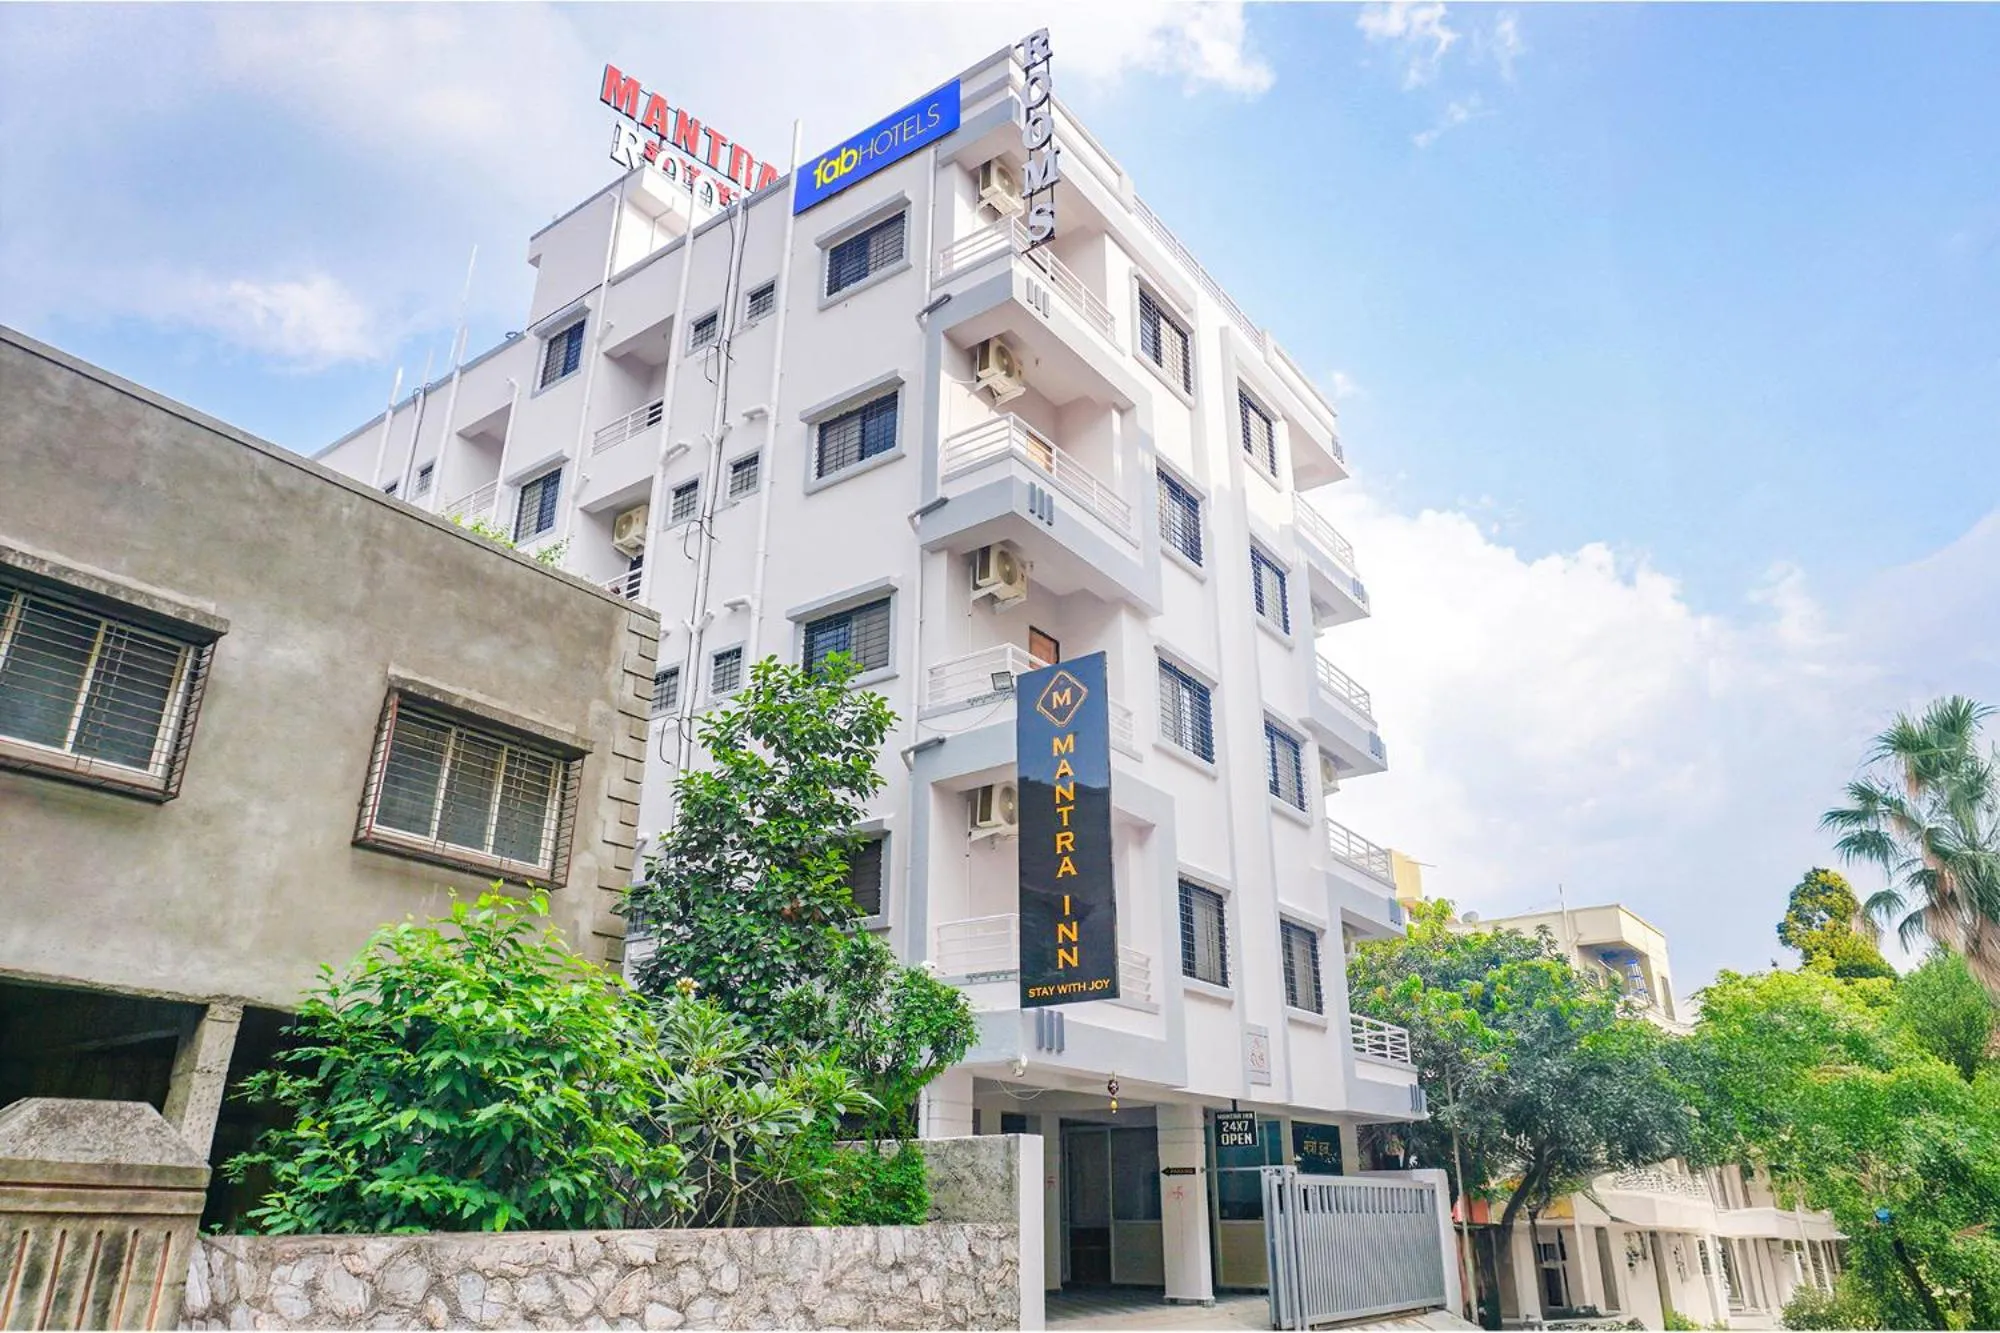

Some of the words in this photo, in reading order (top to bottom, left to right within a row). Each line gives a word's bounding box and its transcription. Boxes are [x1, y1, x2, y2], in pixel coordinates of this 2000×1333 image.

[600, 63, 780, 194] MANTRA
[1019, 27, 1062, 243] ROOMS
[1052, 689, 1071, 709] M
[1052, 734, 1078, 878] MANTRA
[1056, 895, 1079, 970] INN
[1028, 984, 1055, 998] STAY
[1056, 981, 1086, 994] WITH
[1088, 978, 1110, 991] JOY
[1221, 1132, 1253, 1145] OPEN
